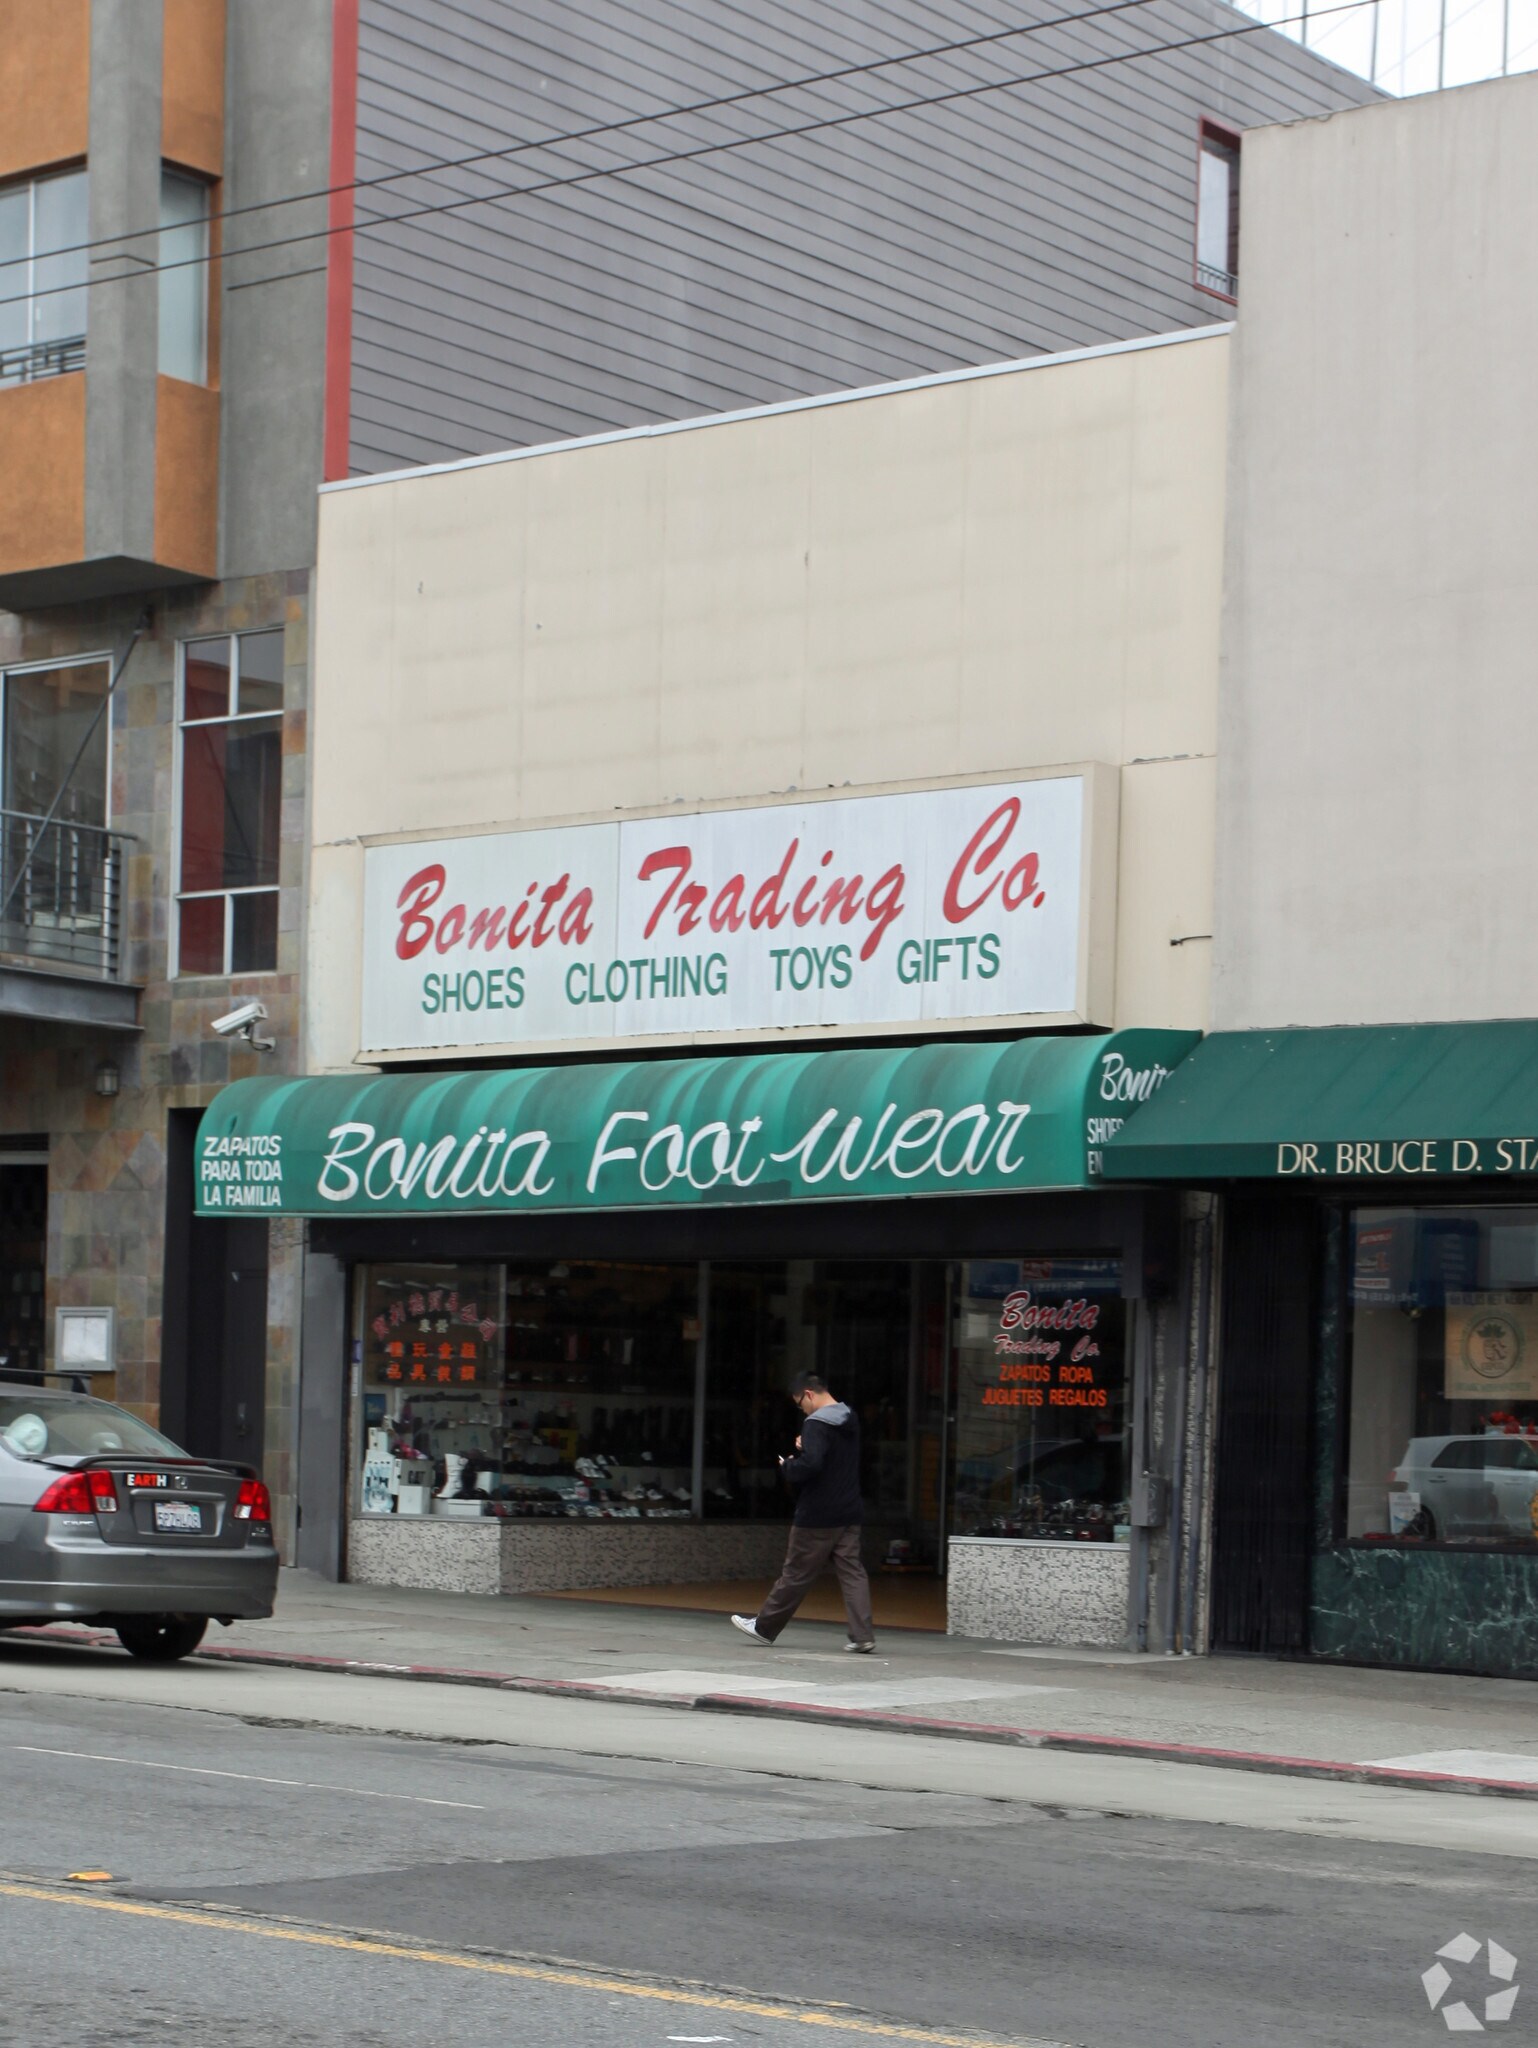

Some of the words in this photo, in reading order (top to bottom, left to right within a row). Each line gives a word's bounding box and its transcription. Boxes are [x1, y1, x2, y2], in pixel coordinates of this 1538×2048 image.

[396, 863, 593, 960] Bonita
[638, 837, 905, 961] Trading
[943, 796, 1045, 924] Co.
[421, 966, 525, 1014] SHOES
[566, 952, 728, 1005] CLOTHING
[770, 944, 853, 992] TOYS
[897, 933, 1001, 985] GIFTS
[203, 1135, 282, 1157] ZAPATOS
[317, 1121, 555, 1201] Bonita
[586, 1111, 765, 1194] Foot
[1277, 1143, 1326, 1174] DR.
[1336, 1141, 1437, 1174] BRUCE
[1452, 1140, 1483, 1172] D.
[201, 1161, 241, 1182] PARA
[245, 1160, 283, 1182] TODA
[203, 1186, 222, 1206] LA
[225, 1185, 282, 1206] FAMILIA
[1000, 1290, 1099, 1330] Bonita
[993, 1333, 1061, 1361] Trading
[1000, 1365, 1050, 1382] ZAPATOS
[1059, 1366, 1093, 1383] ROPA
[982, 1389, 1043, 1406] JUGUETES
[1049, 1389, 1107, 1407] REGALOS
[127, 1473, 167, 1487] EARTH
